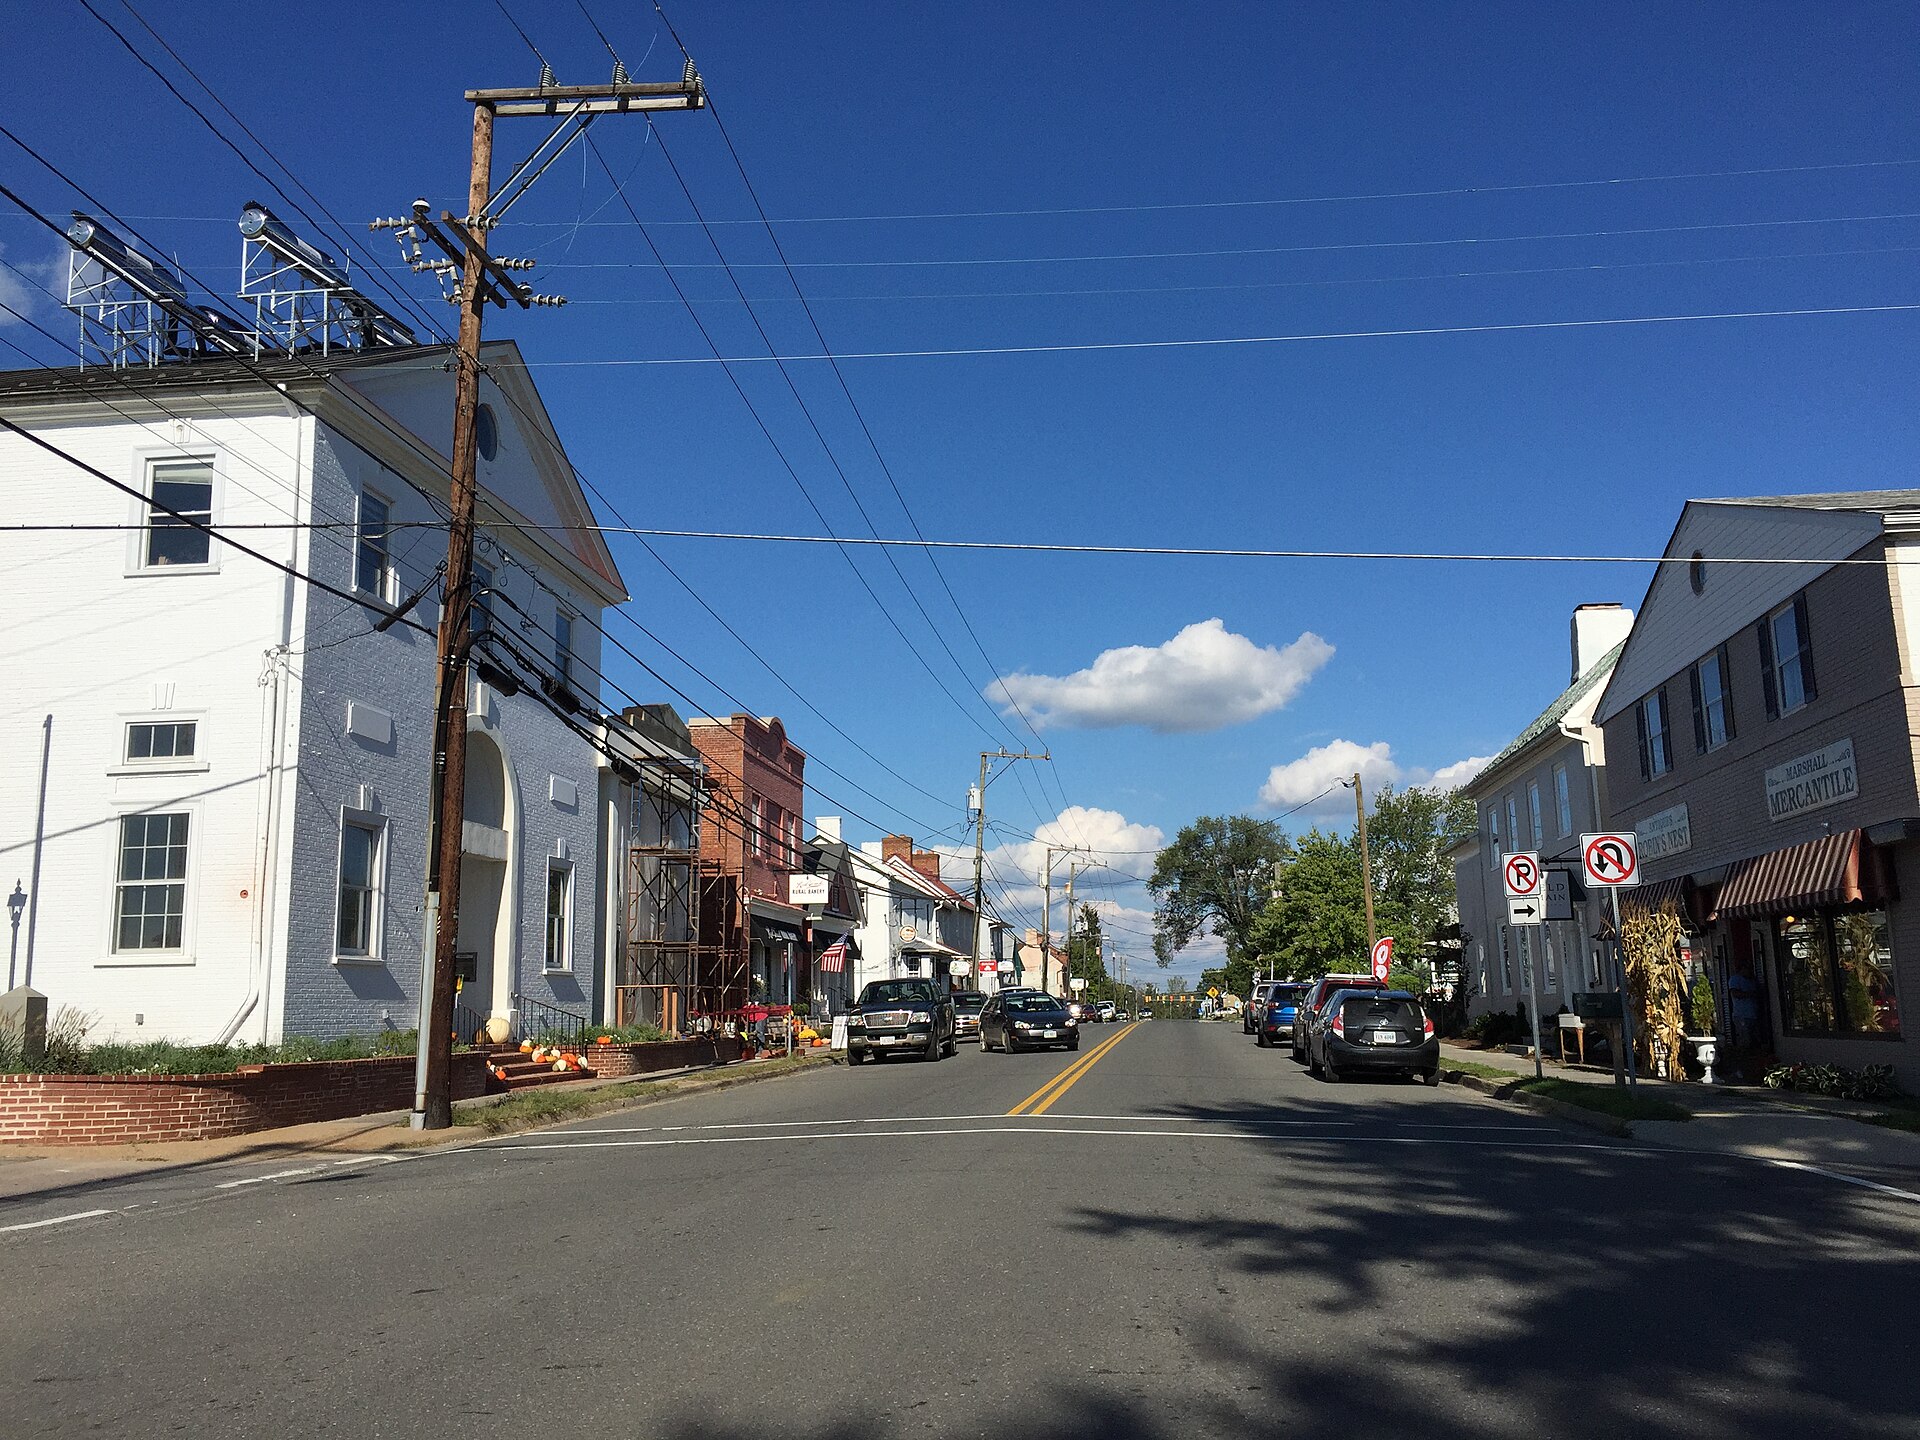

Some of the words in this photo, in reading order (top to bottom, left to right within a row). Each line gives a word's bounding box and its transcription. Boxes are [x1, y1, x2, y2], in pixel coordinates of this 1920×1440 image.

[1785, 754, 1828, 780] MARSHALL
[1769, 766, 1854, 817] MERCANTILE
[1667, 826, 1688, 850] NEST
